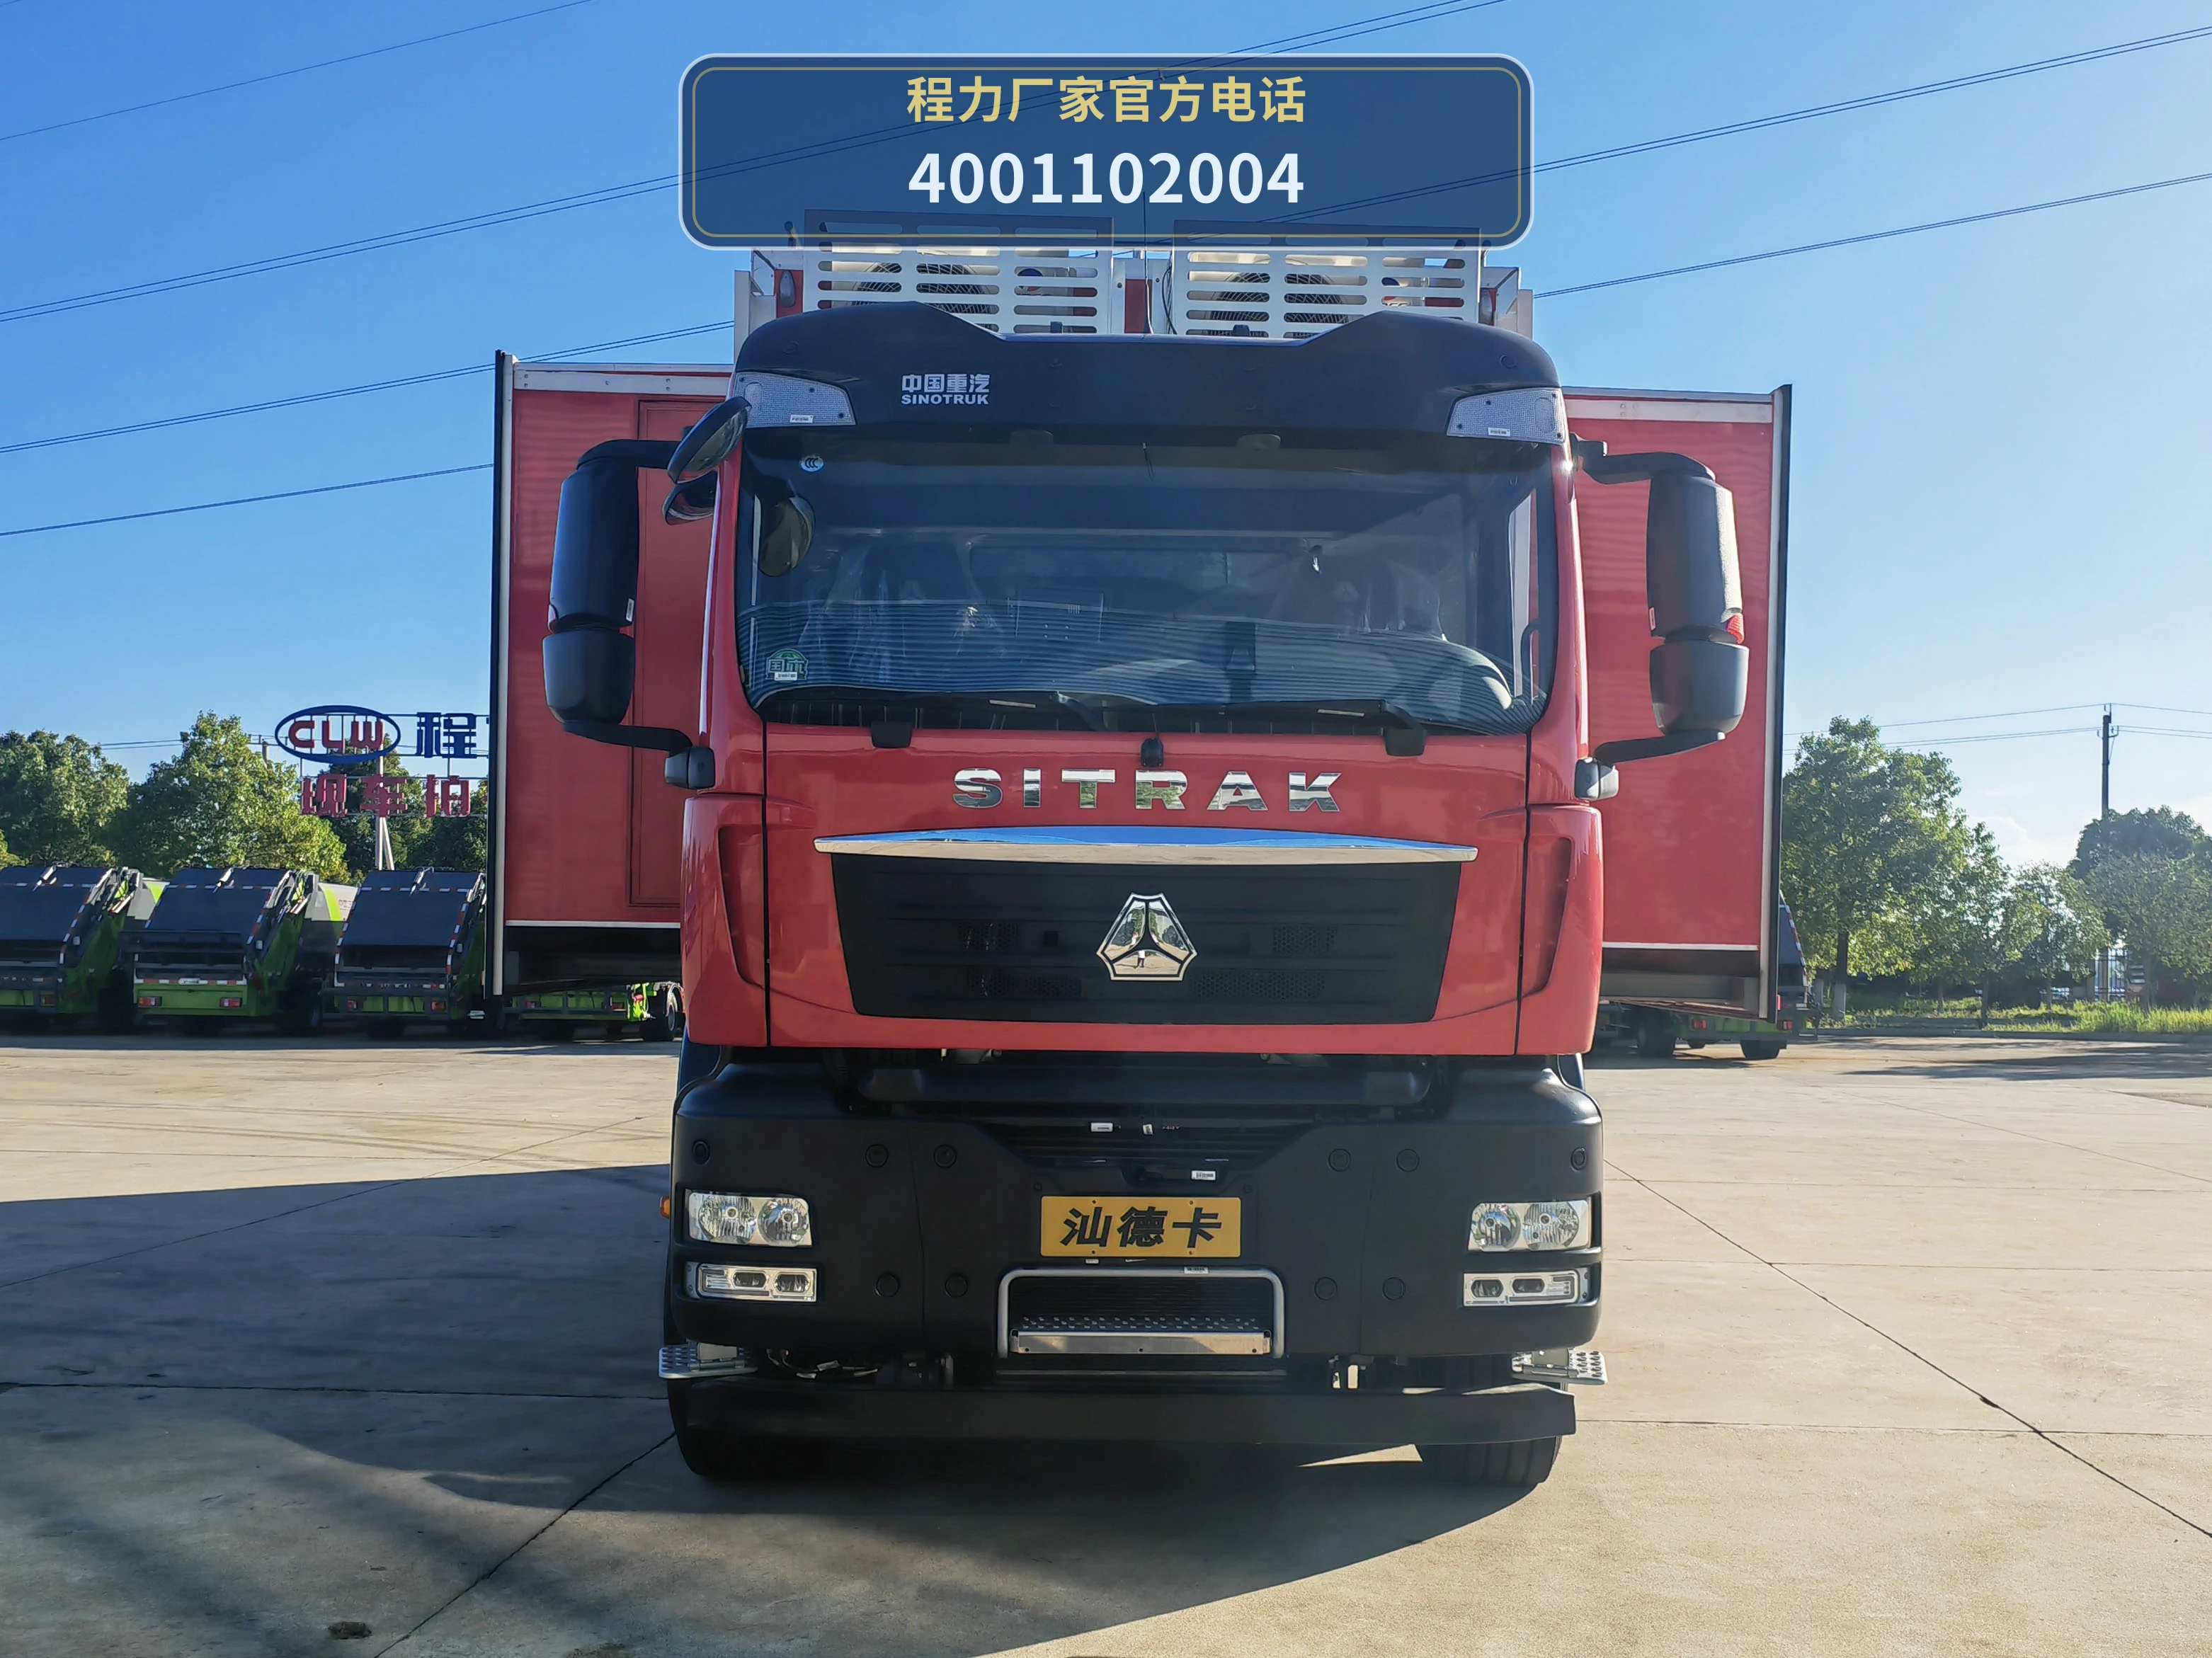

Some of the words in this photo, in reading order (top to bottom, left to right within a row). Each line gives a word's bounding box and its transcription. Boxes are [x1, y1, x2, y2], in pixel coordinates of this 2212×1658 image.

[901, 394, 989, 405] SINOTRUK
[902, 374, 990, 393] 中国重汽
[288, 719, 383, 750] CLW
[416, 712, 477, 759] 程
[952, 768, 1342, 812] SITRAK
[1059, 1206, 1223, 1248] 汕德卡
